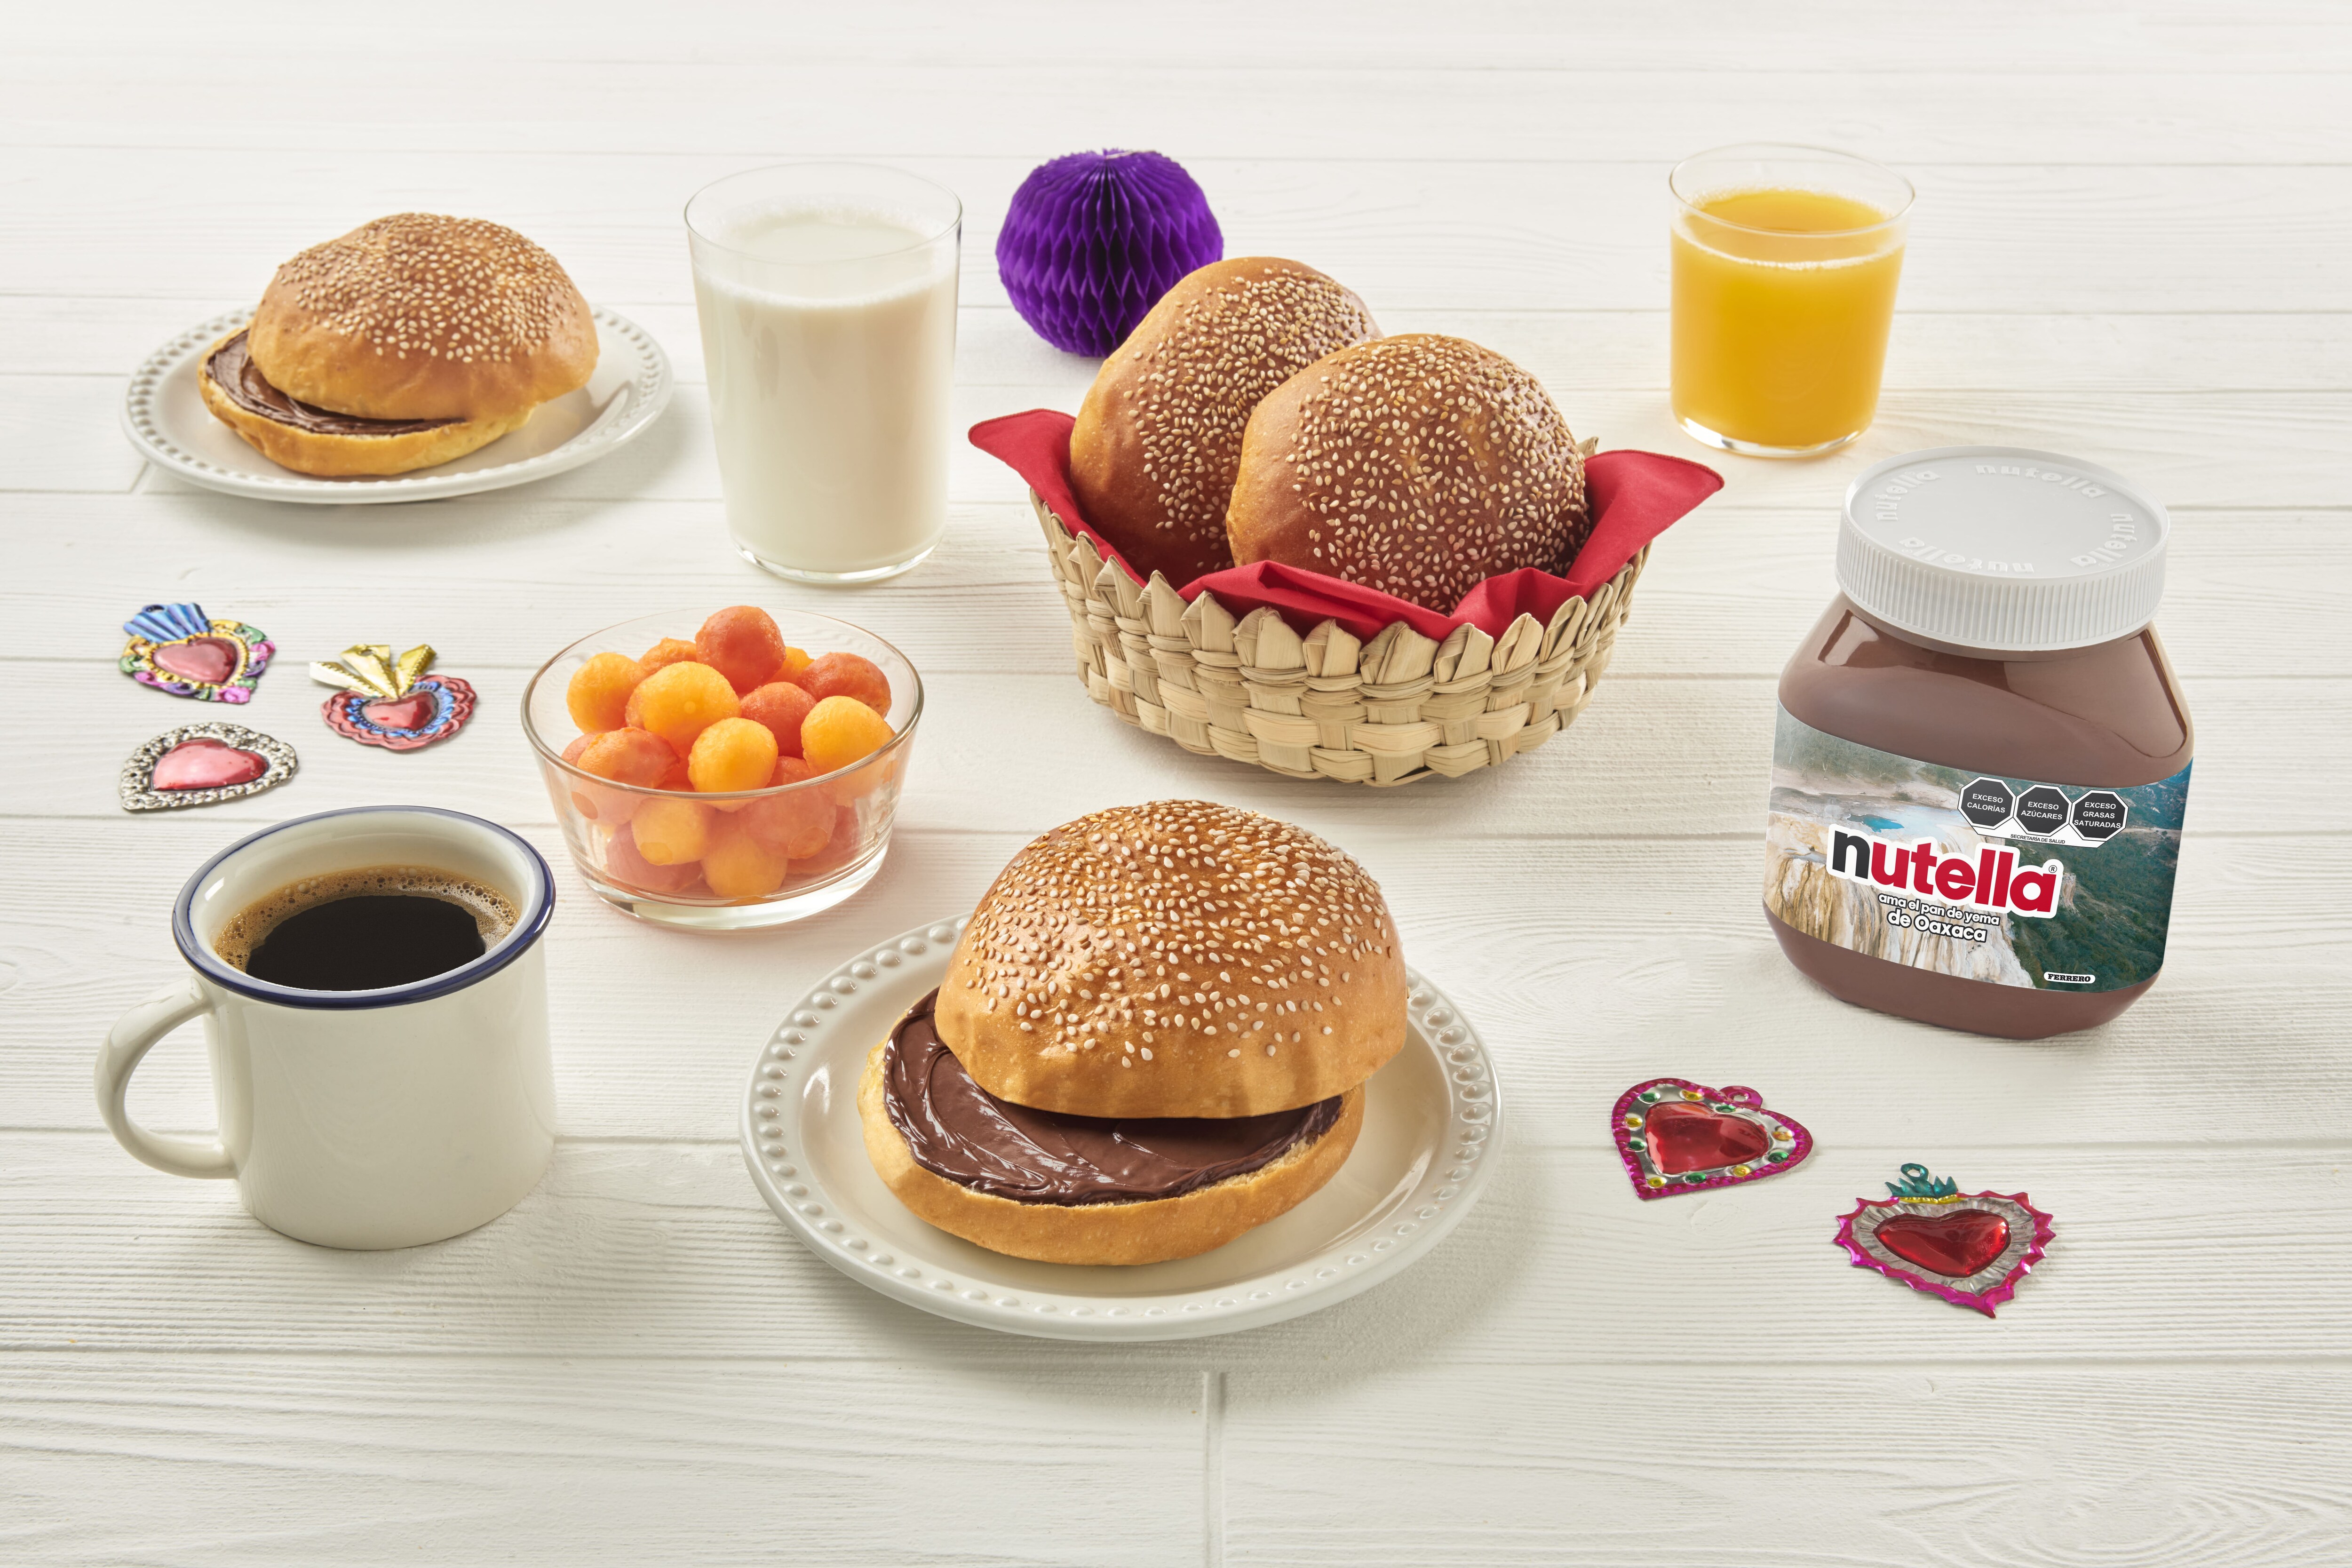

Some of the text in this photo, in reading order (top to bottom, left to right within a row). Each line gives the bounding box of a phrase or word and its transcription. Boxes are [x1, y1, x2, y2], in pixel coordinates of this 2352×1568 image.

[1975, 464, 2107, 498] nutella
[1874, 470, 1942, 521] nutella
[2070, 513, 2137, 566] nutella
[1898, 537, 2035, 573] nutella
[1972, 793, 2003, 804] EXCESO
[1967, 802, 2006, 813] CALORÍAS
[2027, 801, 2059, 811] EXCESO
[2021, 810, 2063, 820] AZÚCARES
[2082, 811, 2115, 819] GRASAS
[2074, 820, 2121, 829] SATURADAS
[2010, 834, 2040, 843] SECRETARÍA
[1879, 893, 2000, 925] ama el pan de yema
[1887, 907, 1987, 942] de Oaxaca
[2048, 973, 2091, 982] FERRERO
